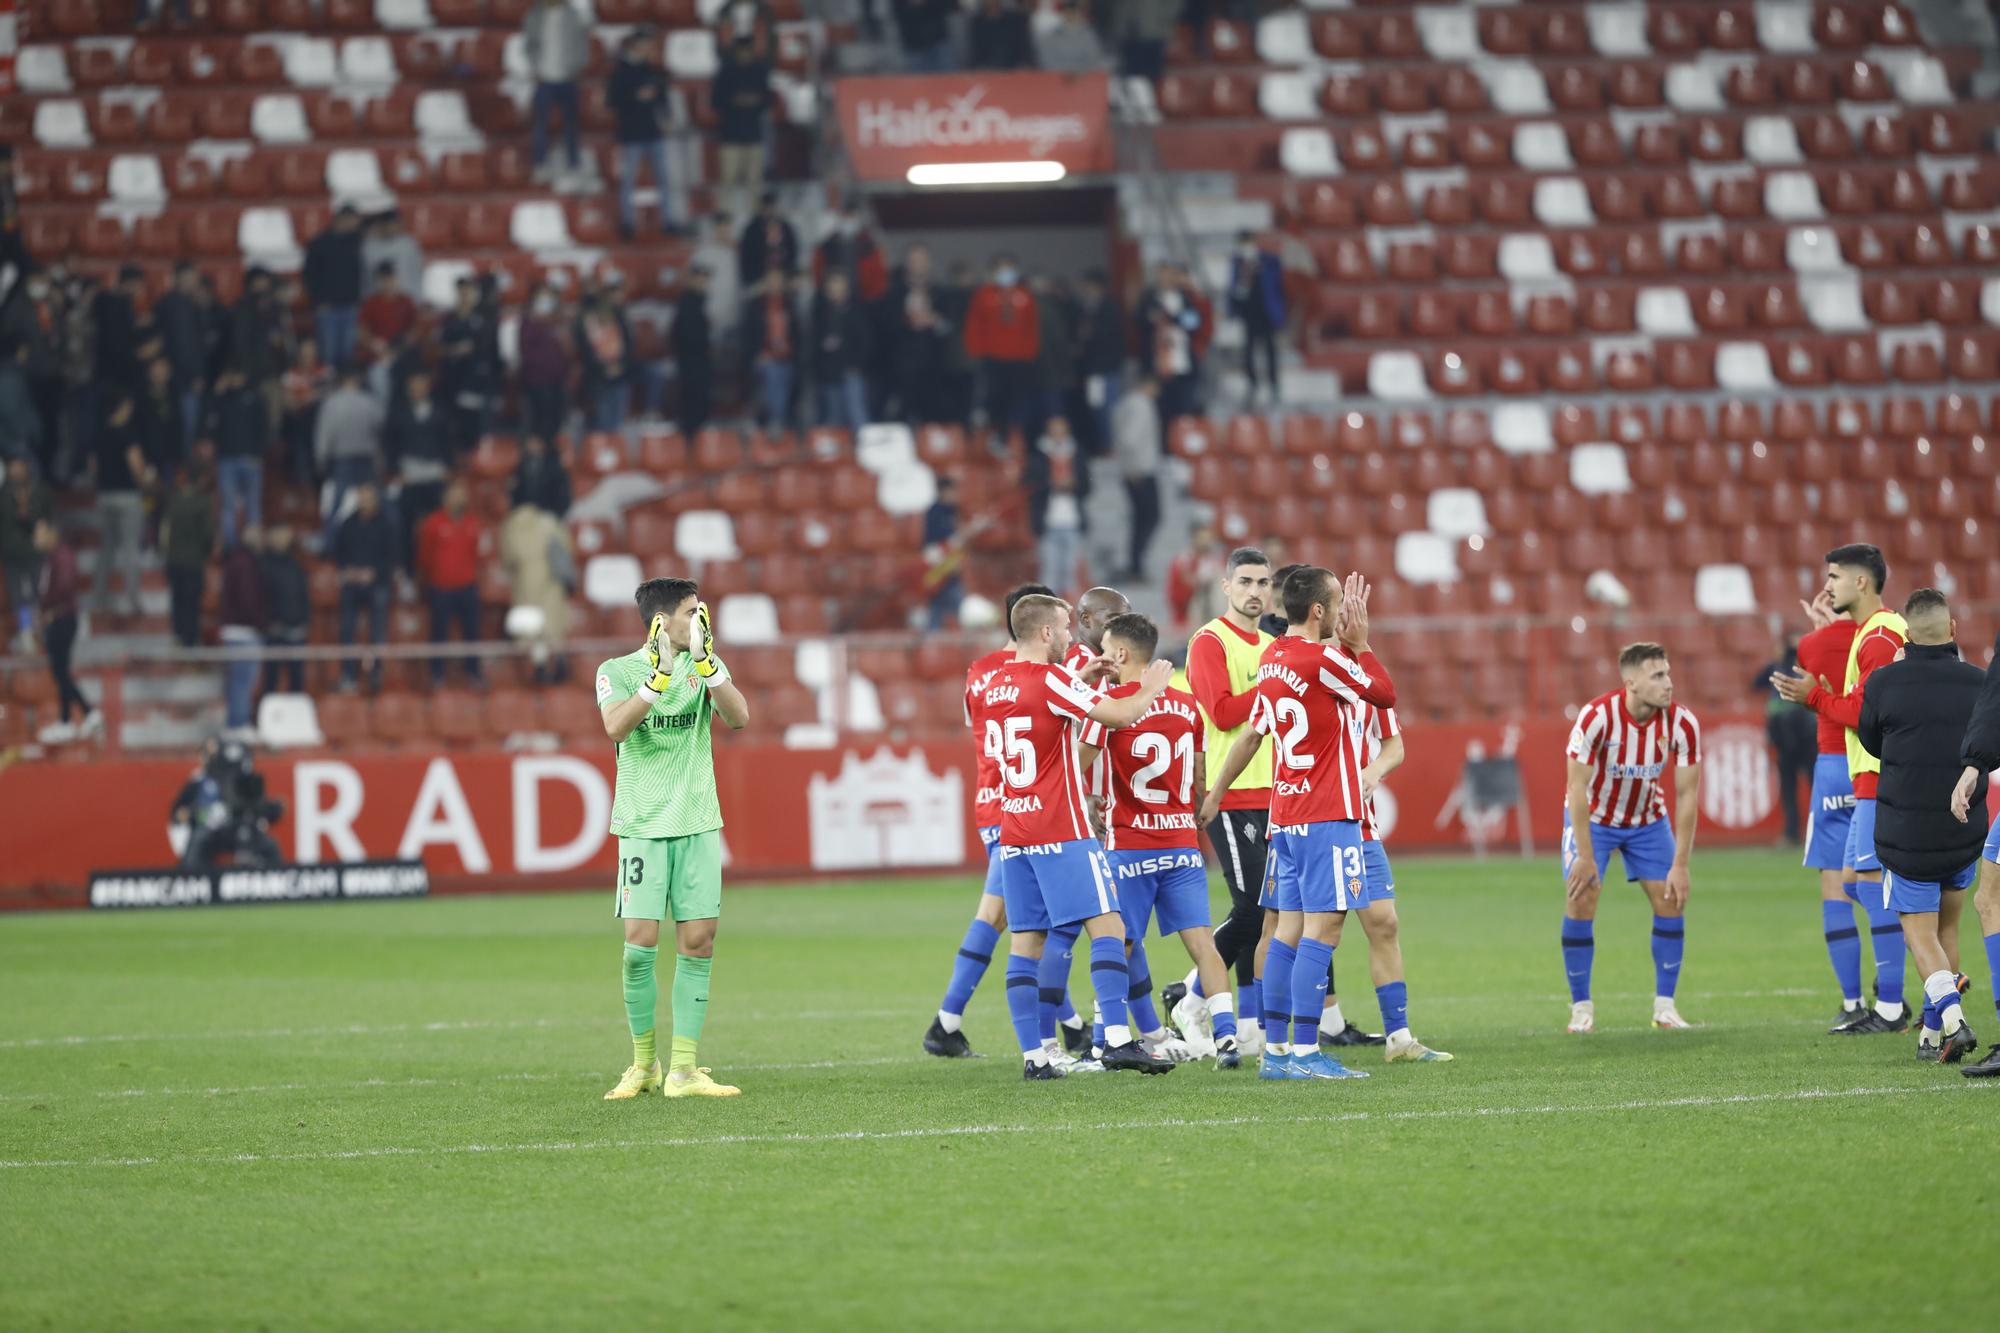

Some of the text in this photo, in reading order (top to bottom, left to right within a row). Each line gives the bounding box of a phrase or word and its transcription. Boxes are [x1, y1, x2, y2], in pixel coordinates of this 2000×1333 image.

[856, 84, 1010, 147] Halcón
[970, 669, 1002, 697] M.V
[1256, 663, 1309, 697] NTAMARIA
[986, 685, 1020, 706] CESAR
[1130, 731, 1195, 805] 21
[622, 856, 645, 886] 13
[1118, 853, 1203, 880] NISSAN
